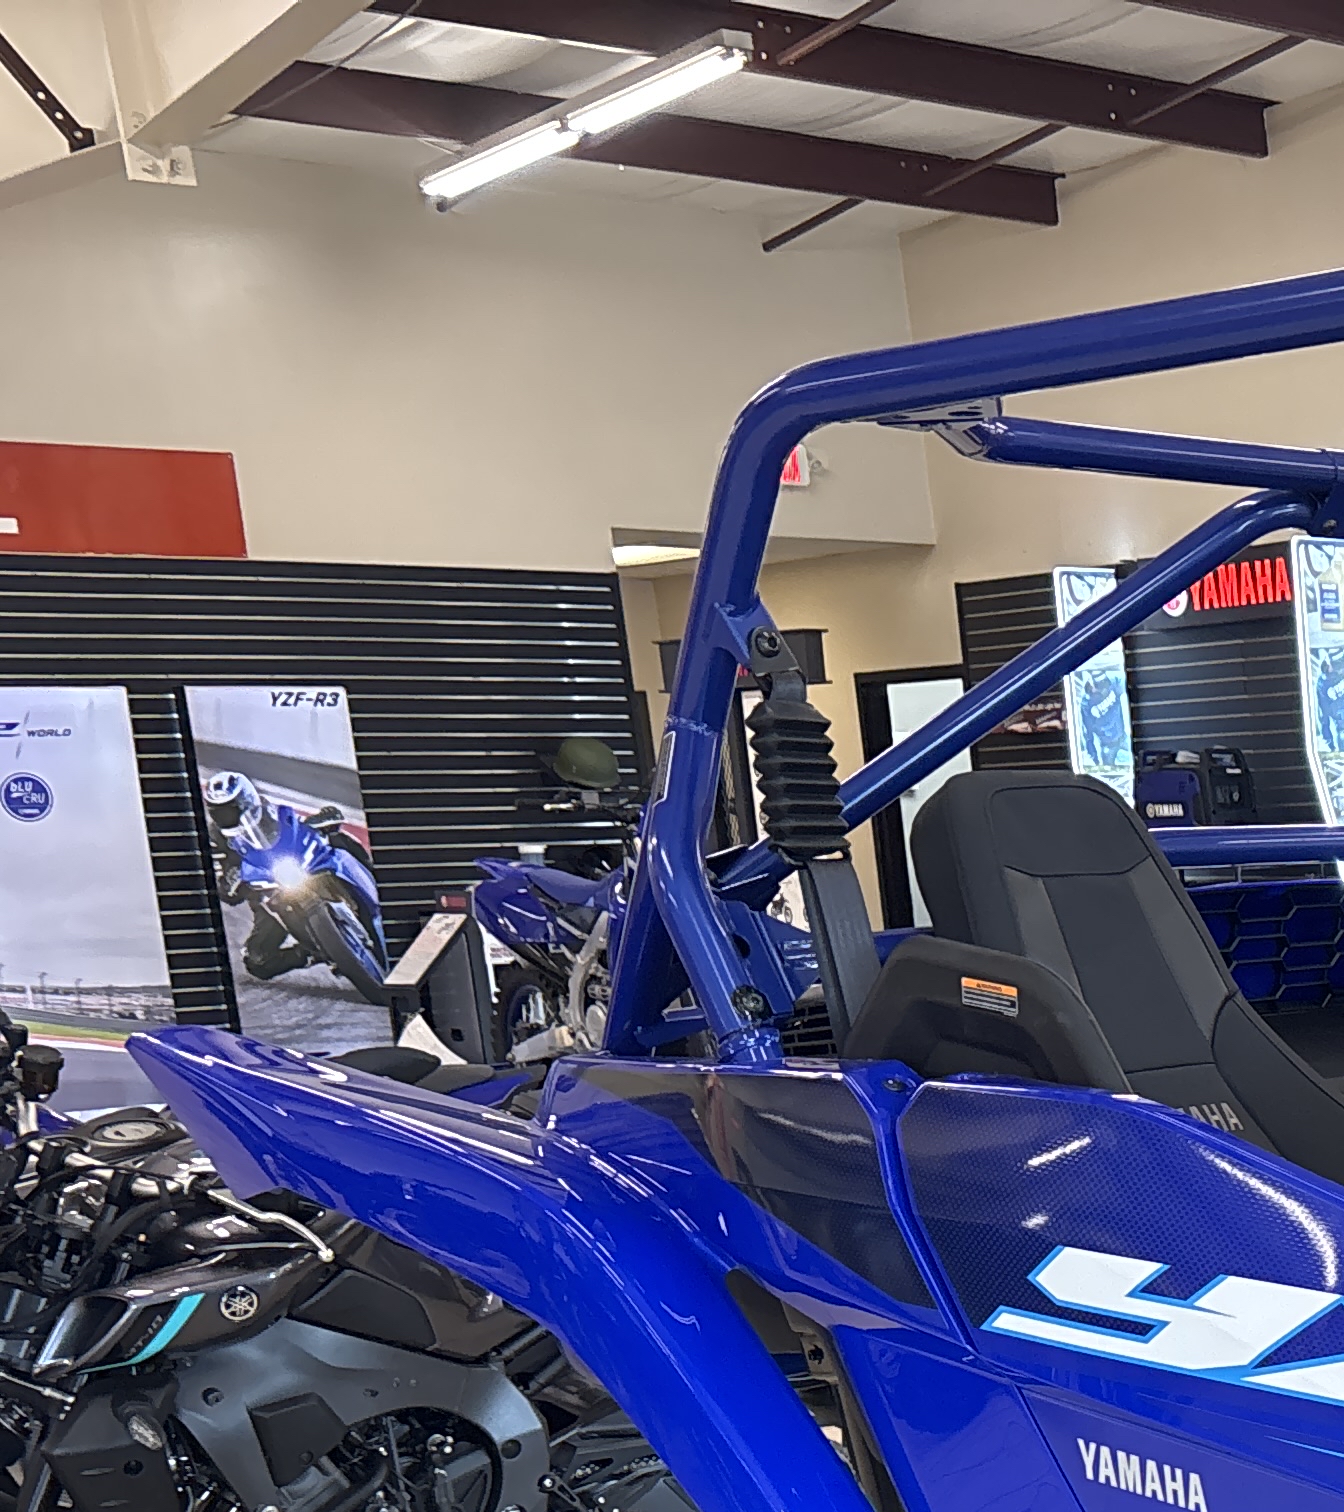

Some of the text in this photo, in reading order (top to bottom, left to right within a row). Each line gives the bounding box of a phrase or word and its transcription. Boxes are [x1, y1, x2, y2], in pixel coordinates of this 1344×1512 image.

[1190, 556, 1291, 611] YAMAHA
[270, 691, 341, 708] YZF-R3
[27, 728, 72, 738] WORLD
[1175, 1101, 1245, 1133] AHA
